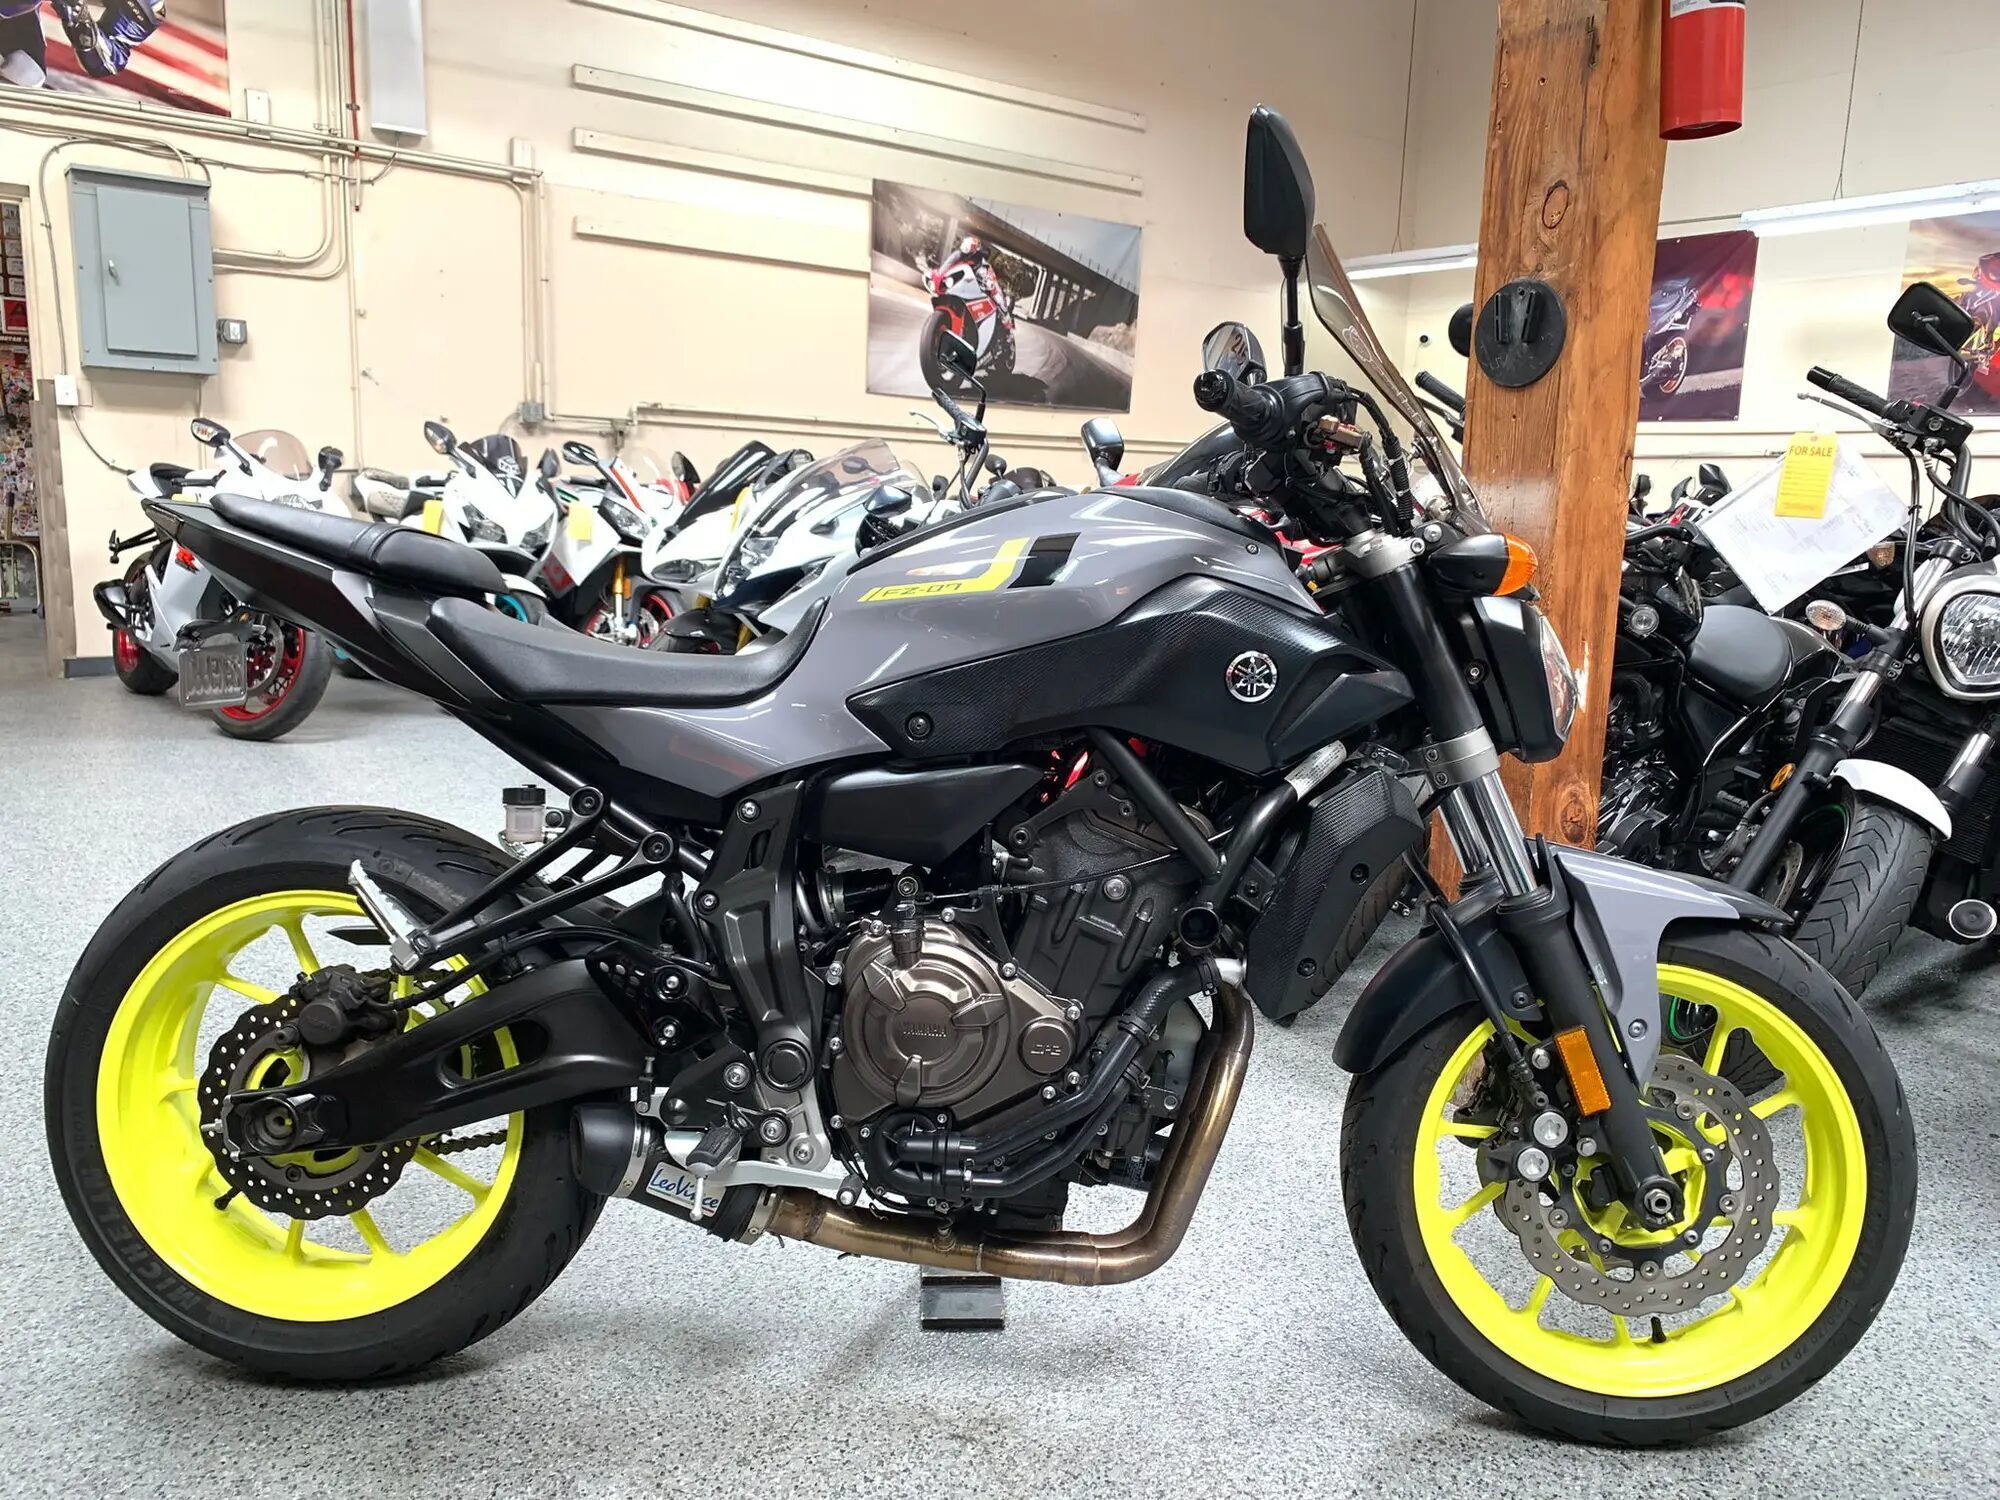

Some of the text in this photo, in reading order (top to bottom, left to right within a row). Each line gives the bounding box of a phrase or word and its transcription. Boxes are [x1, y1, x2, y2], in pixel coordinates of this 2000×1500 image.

[1789, 445, 1833, 457] FOR SALE
[883, 583, 962, 597] FZ-07
[80, 1166, 197, 1311] MICHELIN
